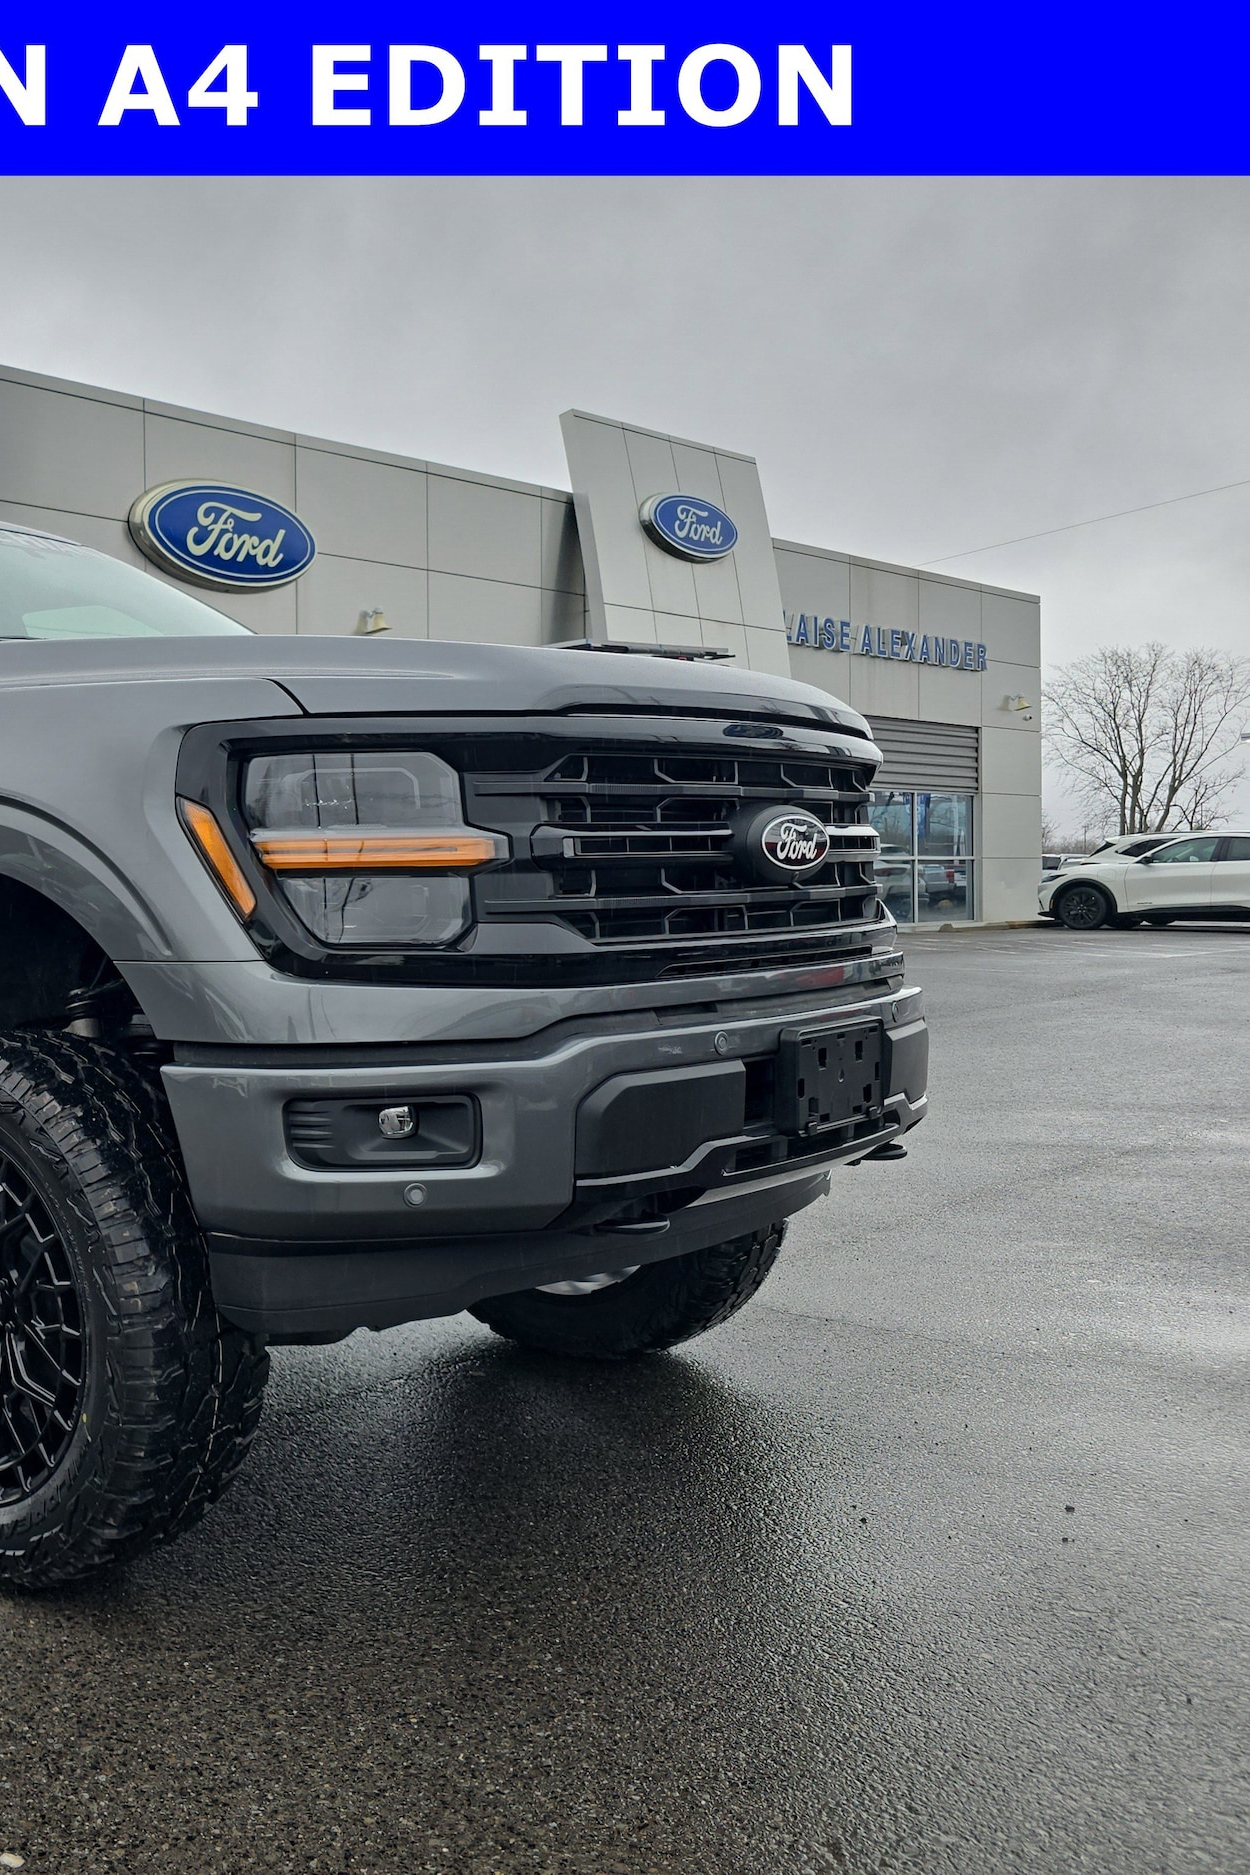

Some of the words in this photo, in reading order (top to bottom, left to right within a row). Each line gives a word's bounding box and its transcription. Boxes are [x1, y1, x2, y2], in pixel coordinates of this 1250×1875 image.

[185, 500, 286, 569] Ford
[673, 504, 724, 546] Ford
[860, 624, 988, 671] ALEXANDER
[776, 822, 818, 861] Ford
